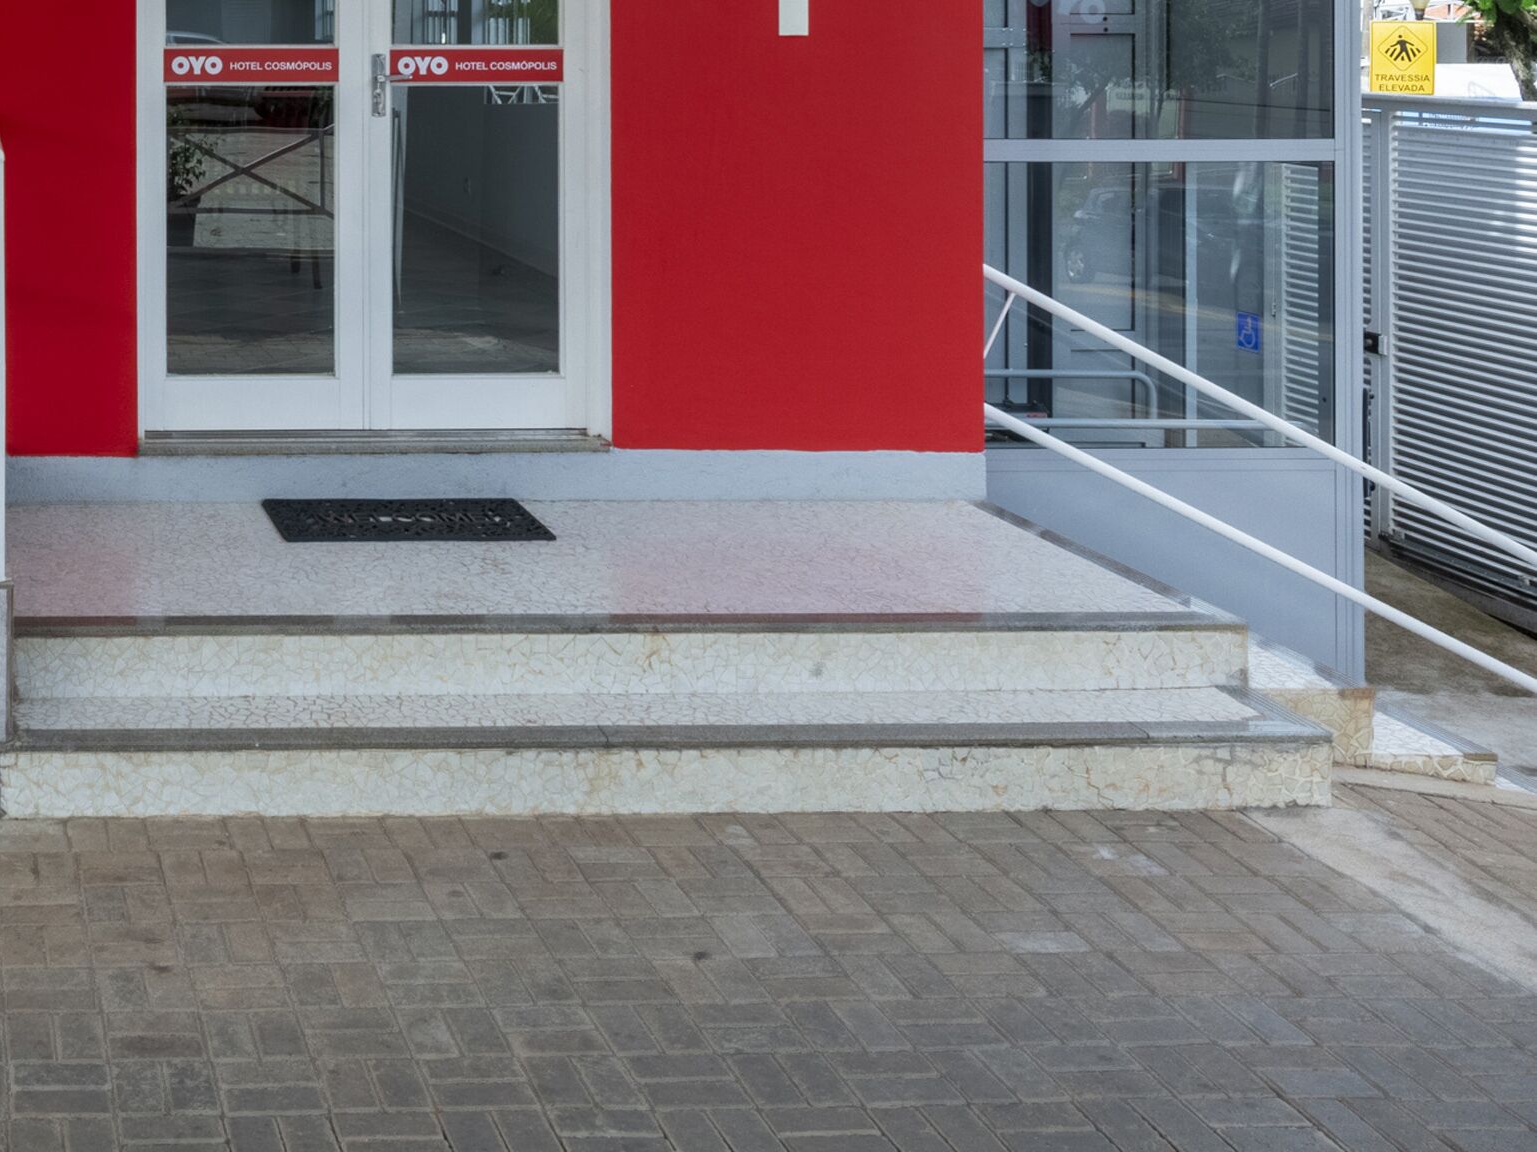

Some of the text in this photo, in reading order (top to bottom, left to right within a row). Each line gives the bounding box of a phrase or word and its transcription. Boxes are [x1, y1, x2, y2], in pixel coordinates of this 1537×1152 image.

[171, 55, 333, 75] OYO HOTEL COSMÓPOLIS
[397, 55, 558, 75] OYO HOTEL COSMÓPOLIS
[1375, 73, 1431, 83] TRAVESSIA
[1378, 83, 1425, 92] ELEVADA
